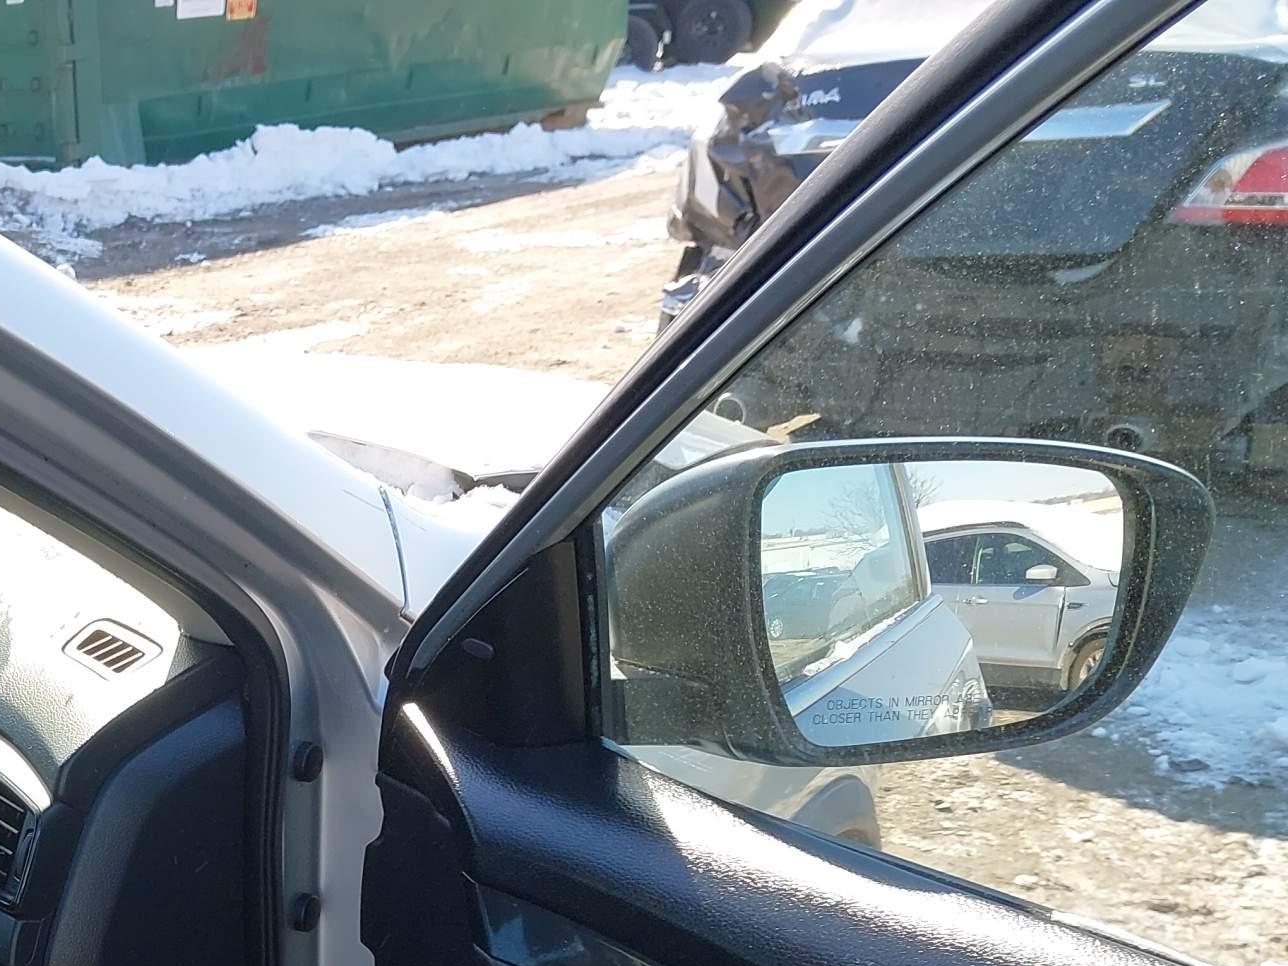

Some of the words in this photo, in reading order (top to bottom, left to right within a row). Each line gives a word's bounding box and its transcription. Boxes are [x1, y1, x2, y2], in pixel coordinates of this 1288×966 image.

[799, 87, 841, 106] IMA
[826, 697, 883, 711] OBJECTS
[887, 696, 900, 709] IN
[904, 694, 949, 707] MIRROR
[954, 693, 982, 704] ARE
[812, 712, 861, 725] CLOSER
[868, 710, 900, 723] THAN
[907, 707, 935, 720] THEY
[943, 705, 993, 719] APPR
